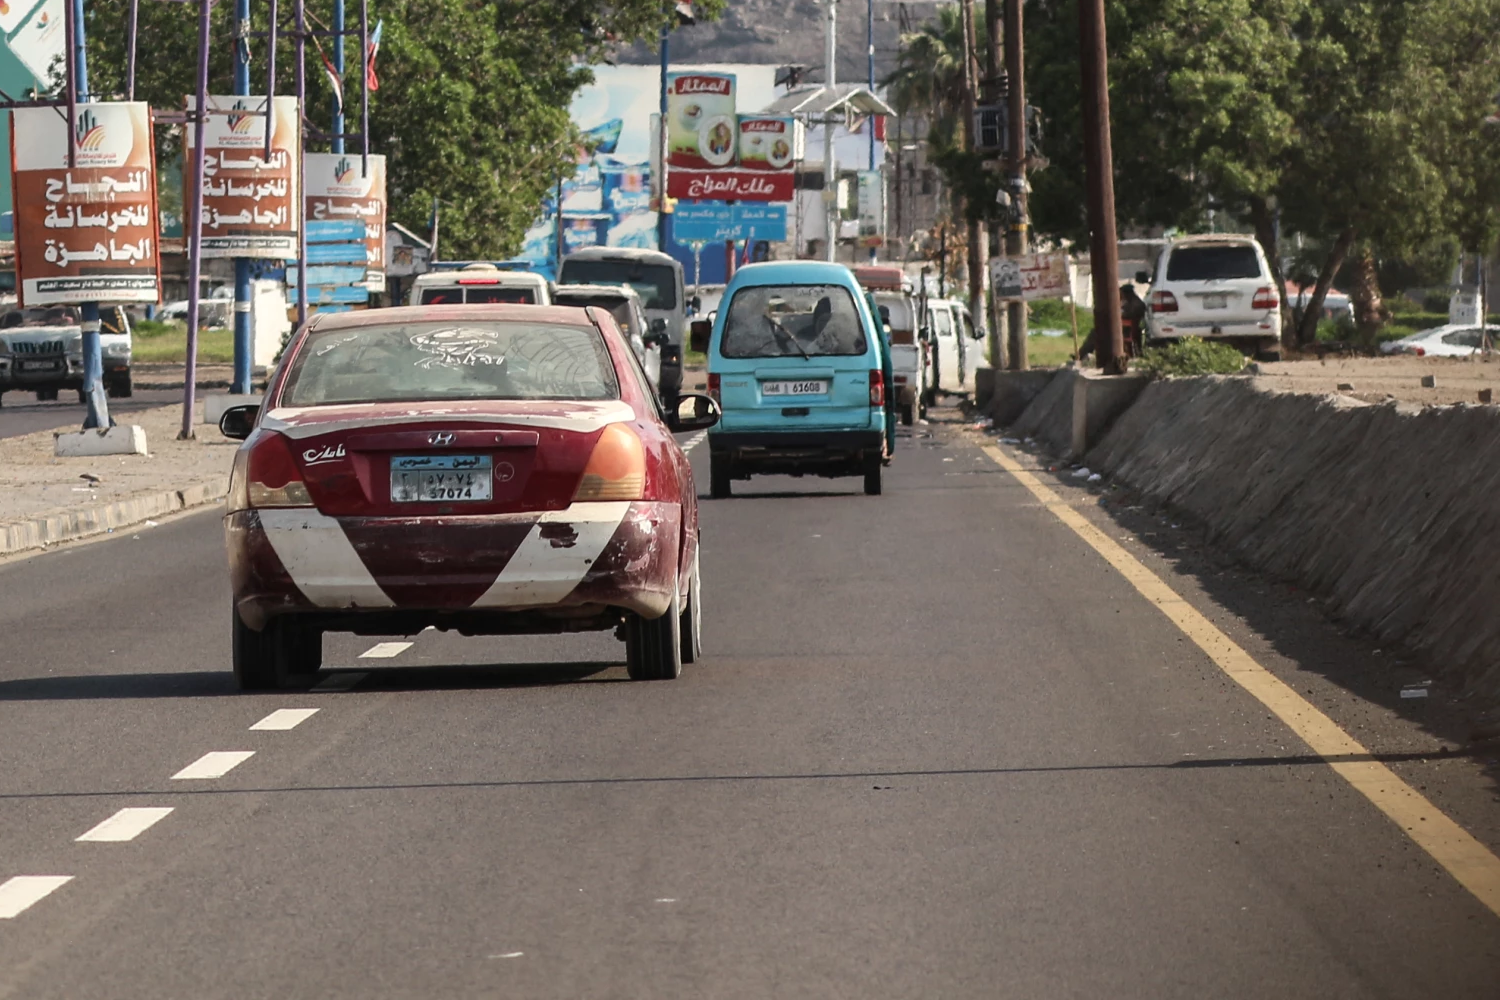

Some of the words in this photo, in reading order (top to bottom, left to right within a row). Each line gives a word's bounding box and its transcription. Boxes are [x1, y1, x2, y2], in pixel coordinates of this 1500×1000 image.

[45, 170, 147, 202] النجاح
[202, 178, 287, 201] للخرسانة
[44, 204, 149, 233] للخرسانة
[201, 205, 287, 229] الجاهزة
[313, 198, 380, 219] النجاح
[44, 238, 150, 268] الجاهزة
[452, 456, 481, 467] اليمن
